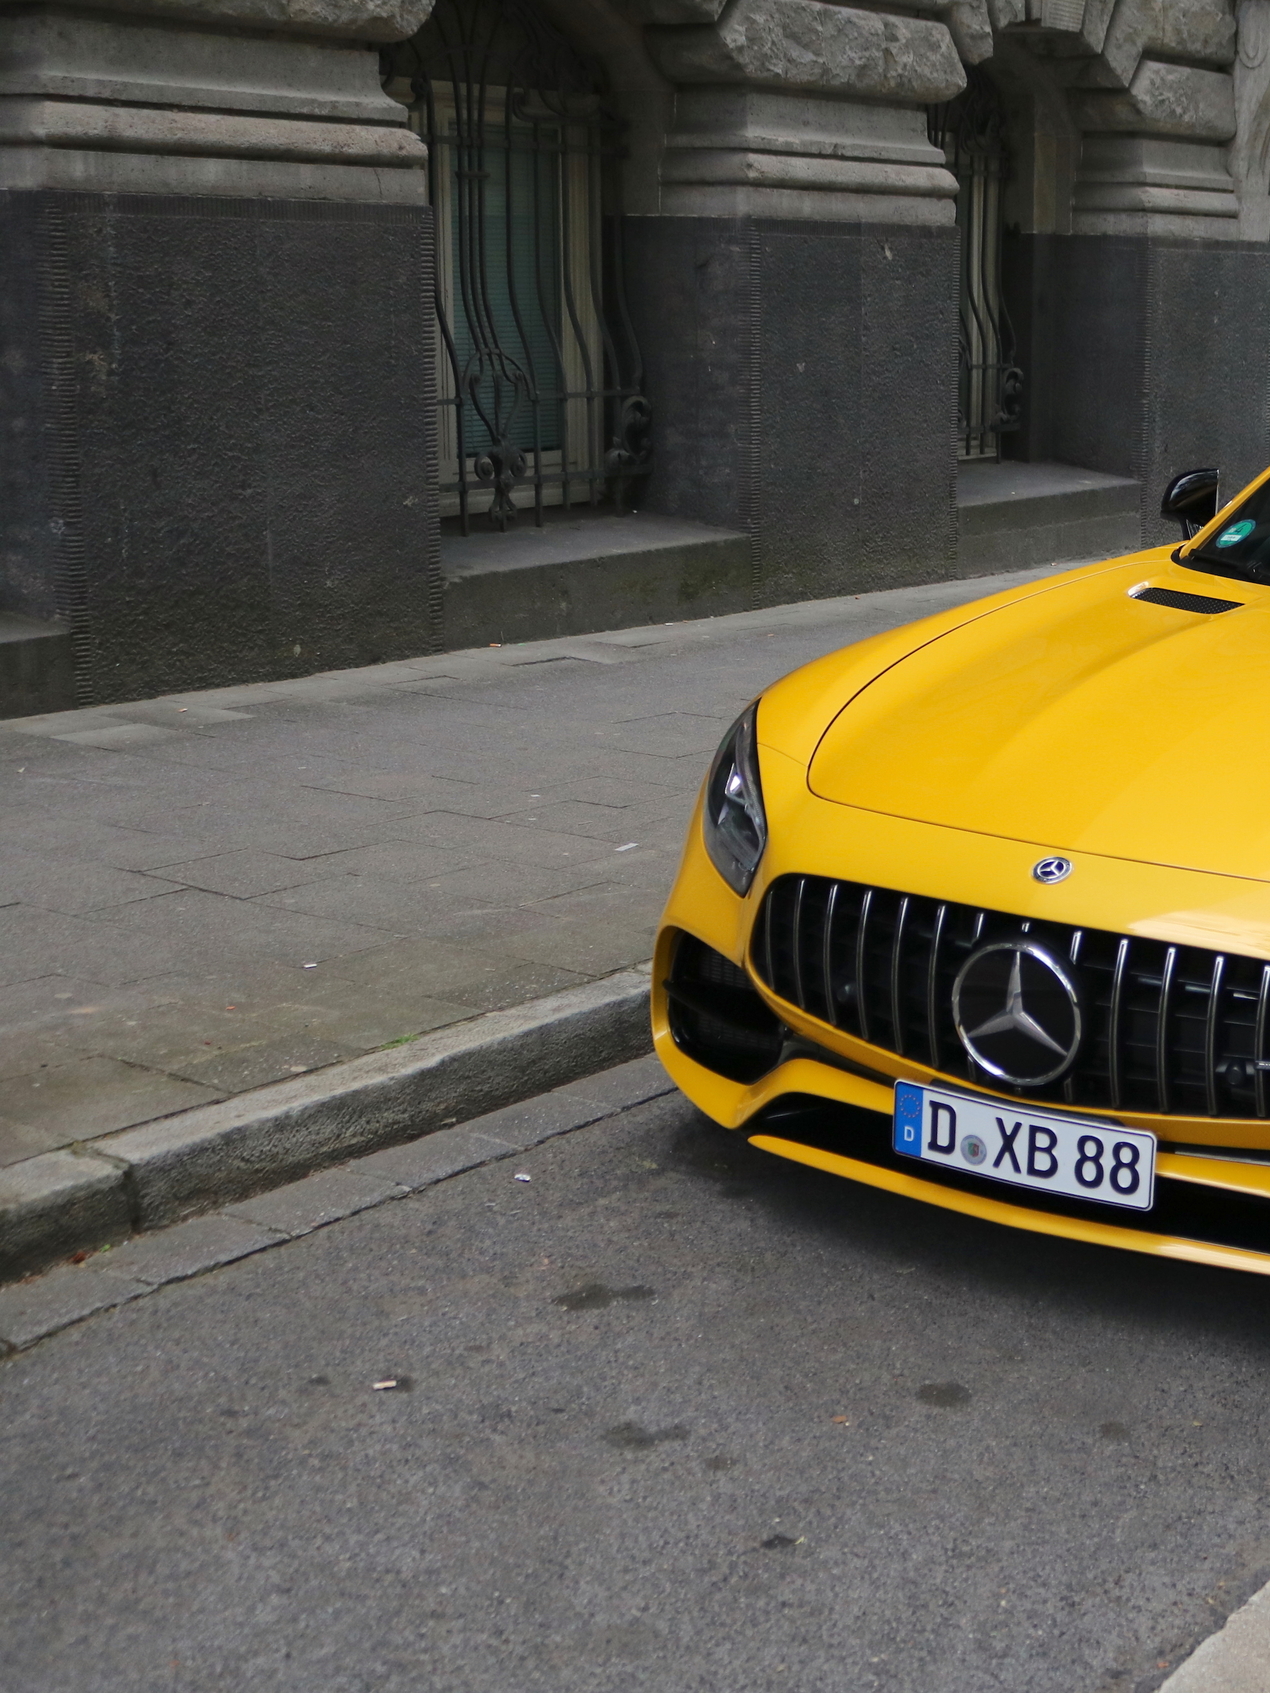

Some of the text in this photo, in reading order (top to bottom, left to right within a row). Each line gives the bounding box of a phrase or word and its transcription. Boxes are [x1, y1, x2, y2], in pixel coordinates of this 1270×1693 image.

[904, 1125, 914, 1142] D
[927, 1099, 1141, 1196] D XB 88
